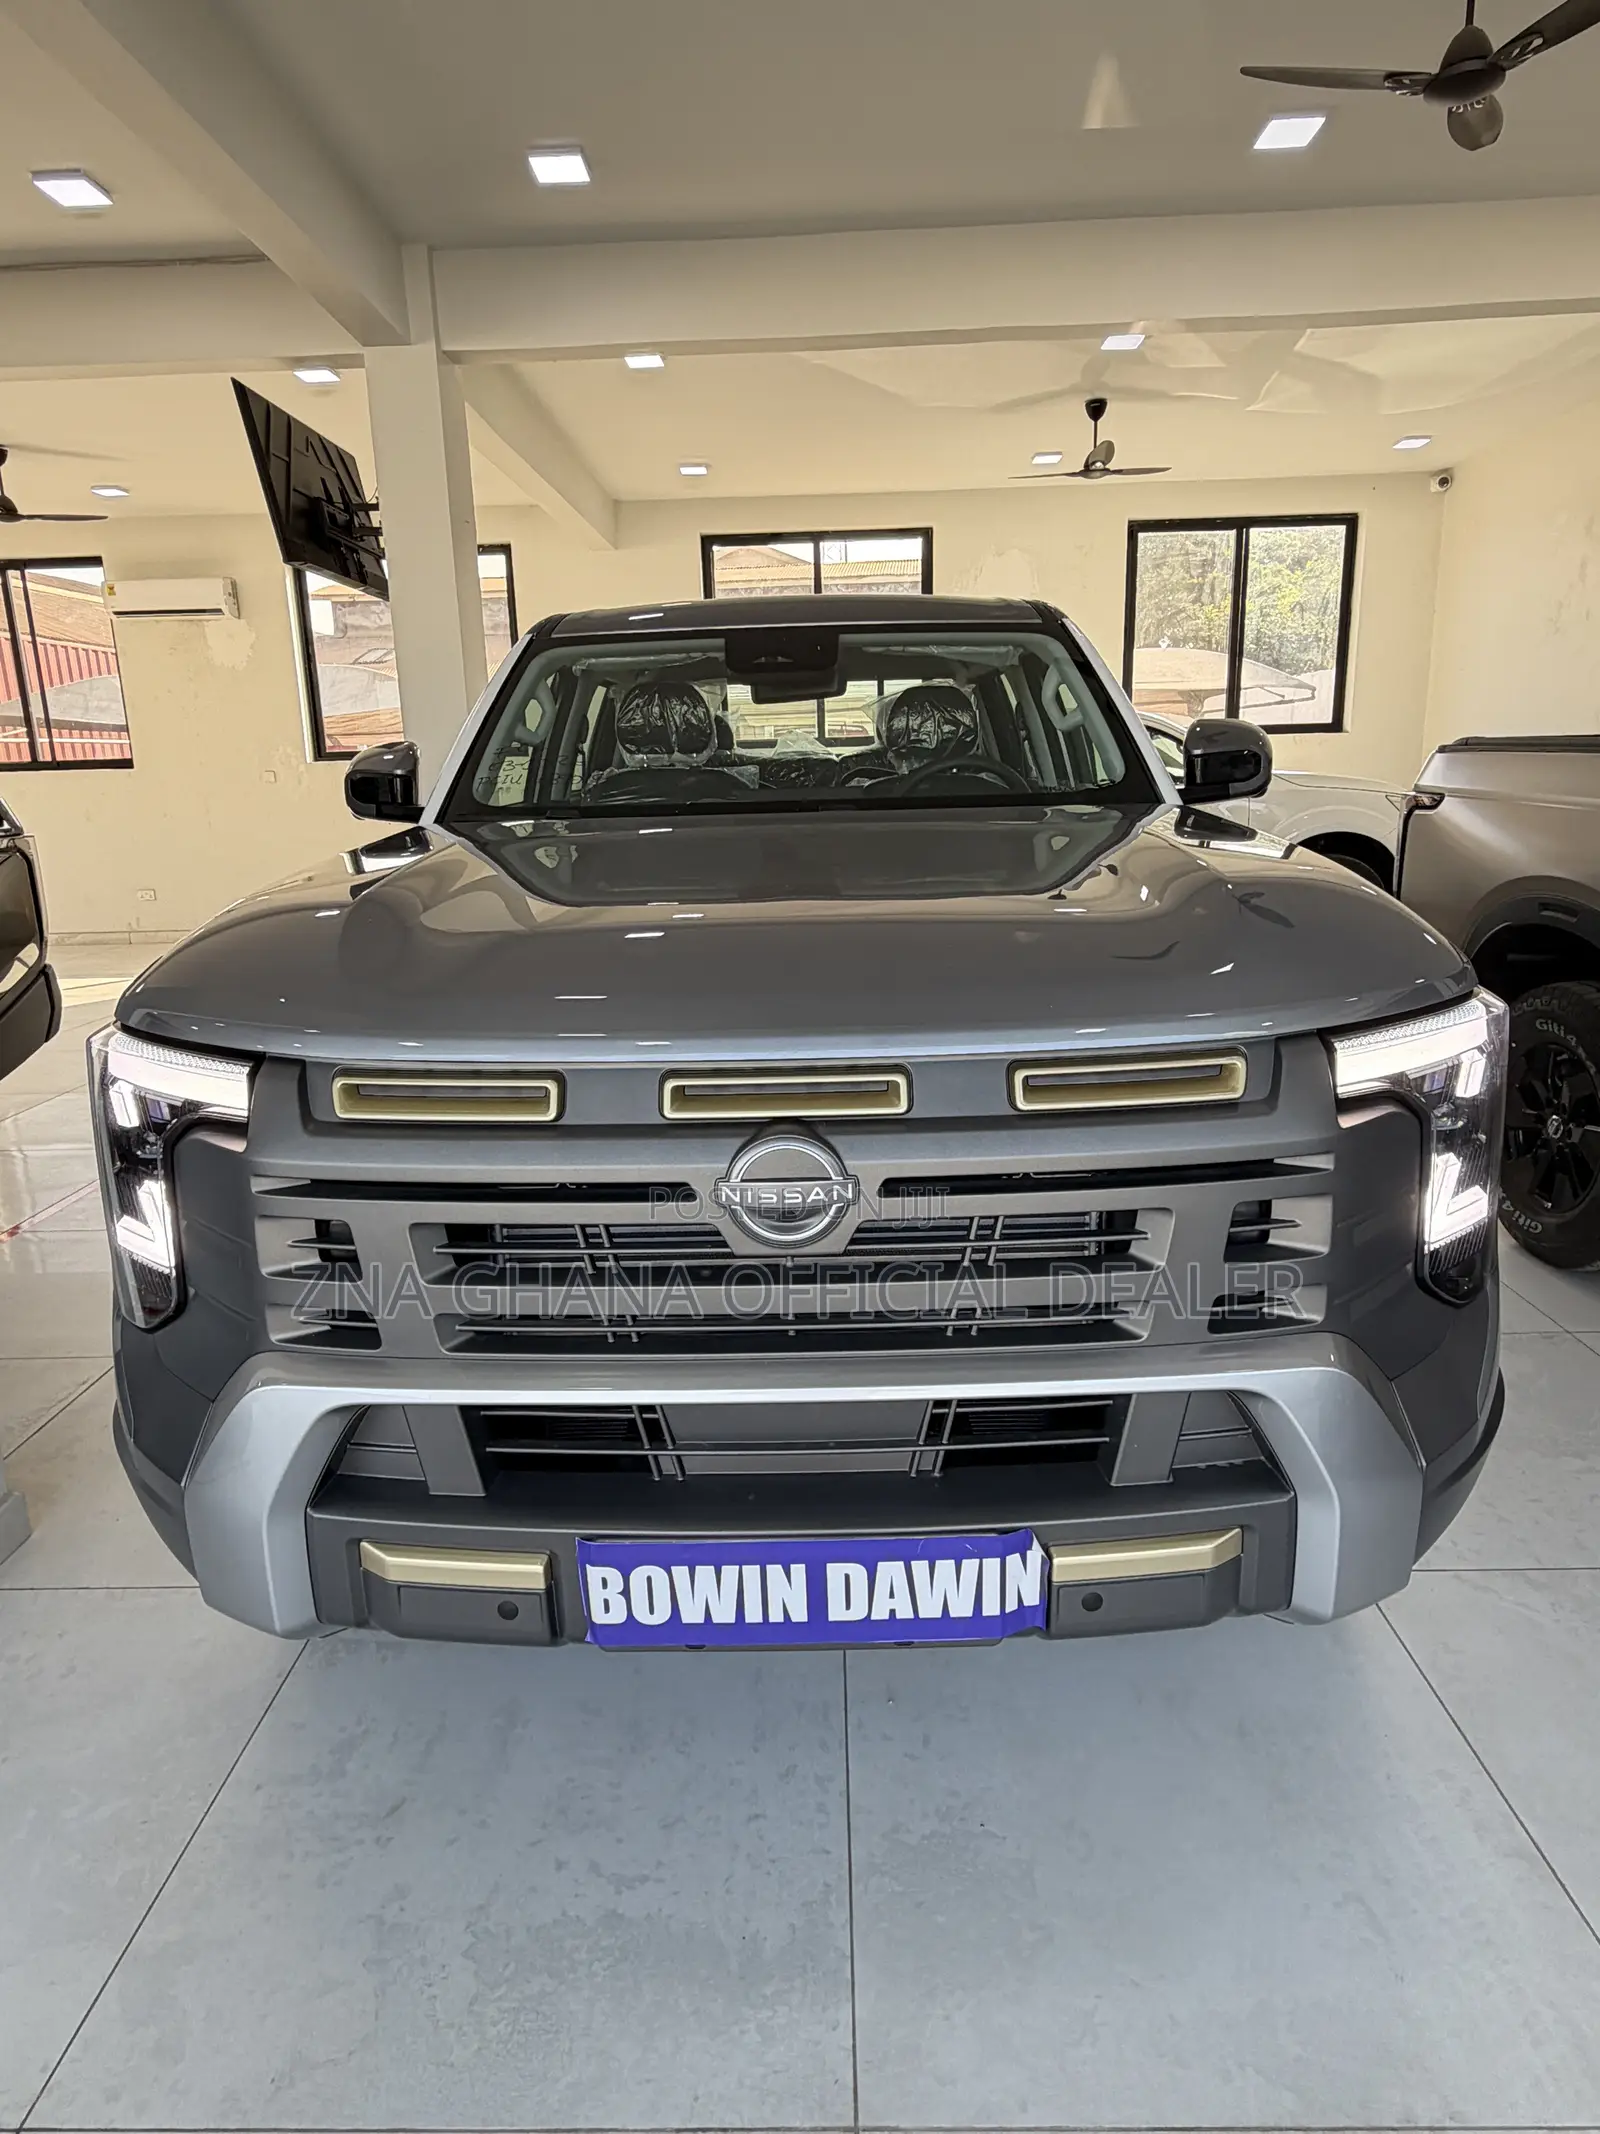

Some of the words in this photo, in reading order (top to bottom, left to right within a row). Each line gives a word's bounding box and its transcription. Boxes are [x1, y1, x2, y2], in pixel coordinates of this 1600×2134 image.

[720, 1183, 853, 1204] NISSAN
[586, 1563, 809, 1626] BOWIN
[826, 1549, 1042, 1622] DAWIN
